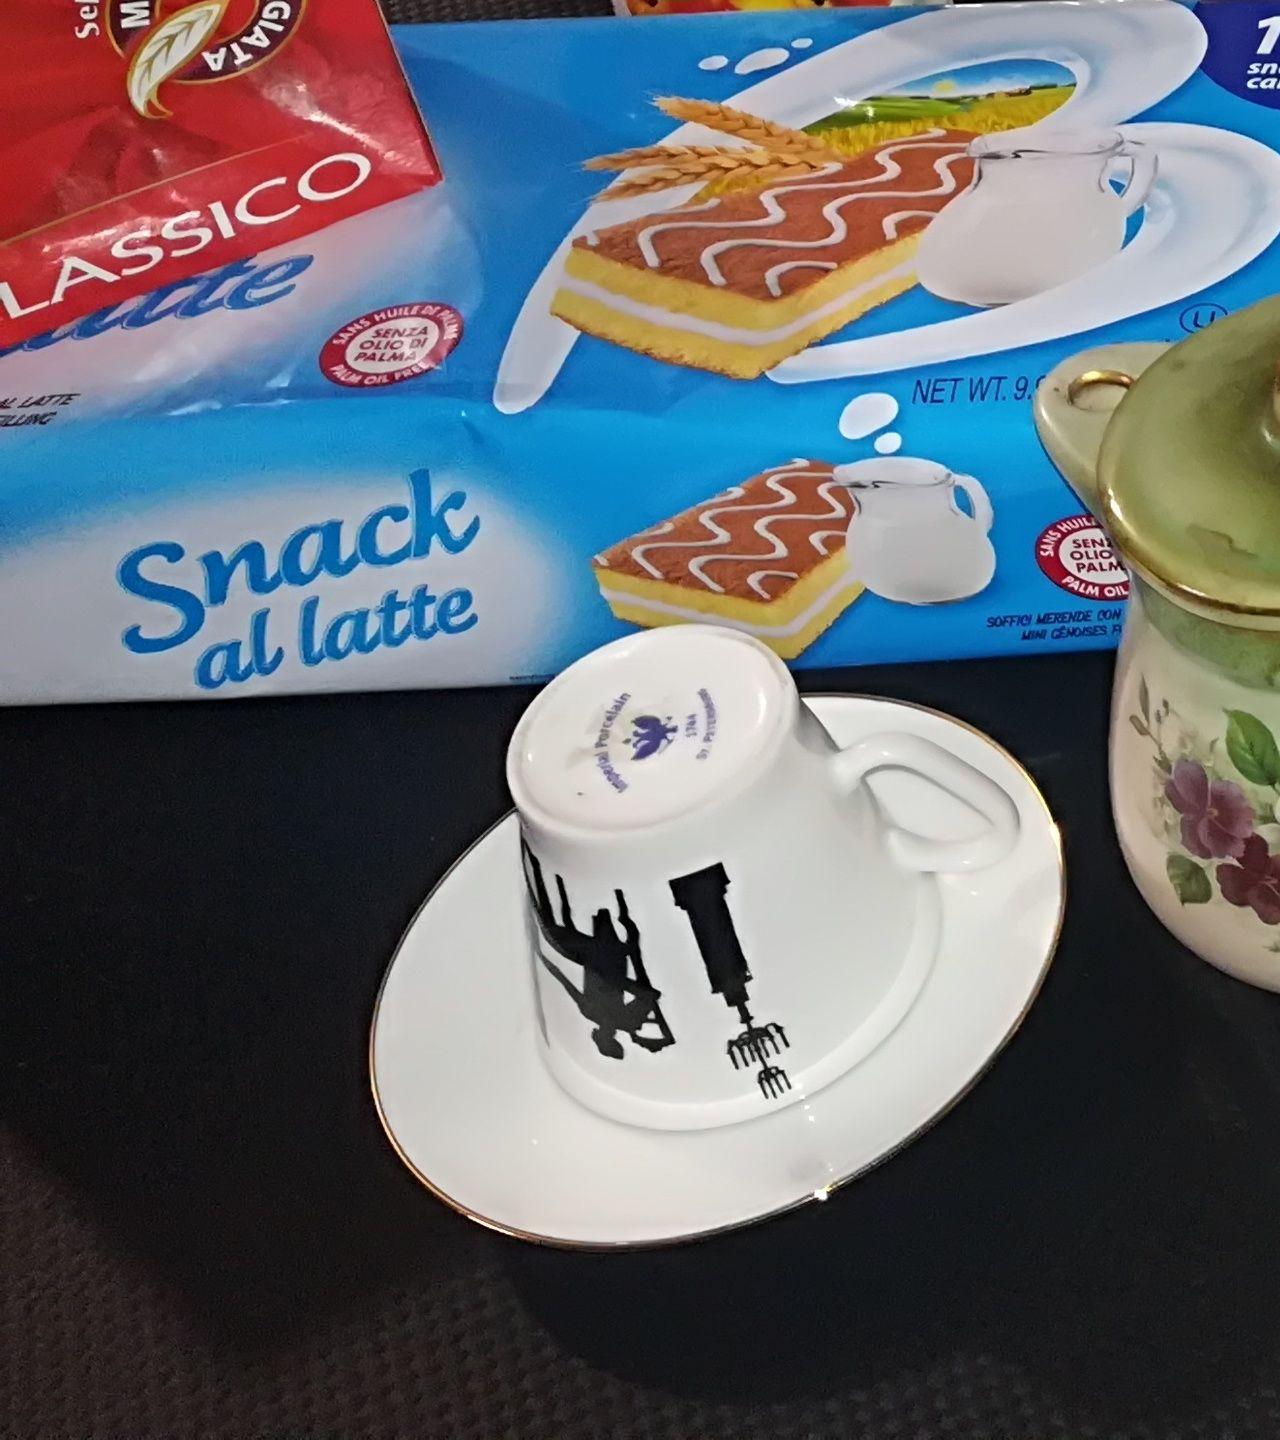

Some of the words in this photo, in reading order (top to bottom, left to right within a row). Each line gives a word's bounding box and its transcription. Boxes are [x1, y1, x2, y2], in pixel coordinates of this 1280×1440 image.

[0, 152, 372, 320] LASSICO
[333, 318, 371, 345] SANS
[374, 305, 420, 322] HUILE
[372, 326, 429, 338] SENZA
[359, 339, 403, 350] OLIO
[408, 337, 428, 349] DI
[353, 351, 417, 362] PALMA
[330, 364, 361, 384] PALM
[364, 375, 390, 385] OIL
[22, 393, 81, 408] LATTE
[912, 377, 962, 404] NET
[967, 376, 1005, 402] WT.
[1040, 530, 1062, 558] SANS
[115, 467, 481, 655] Snack
[1070, 550, 1113, 560] OLIO
[1077, 562, 1125, 573] PALM
[1062, 576, 1100, 597] PALM
[1104, 586, 1129, 597] OIL
[986, 615, 1032, 628] SOFFICI
[1036, 612, 1091, 624] MERENDE
[1097, 609, 1121, 621] CON
[194, 602, 283, 690] al
[301, 578, 479, 668] latte
[1021, 630, 1046, 640] MINI
[594, 692, 631, 748] Porcelain
